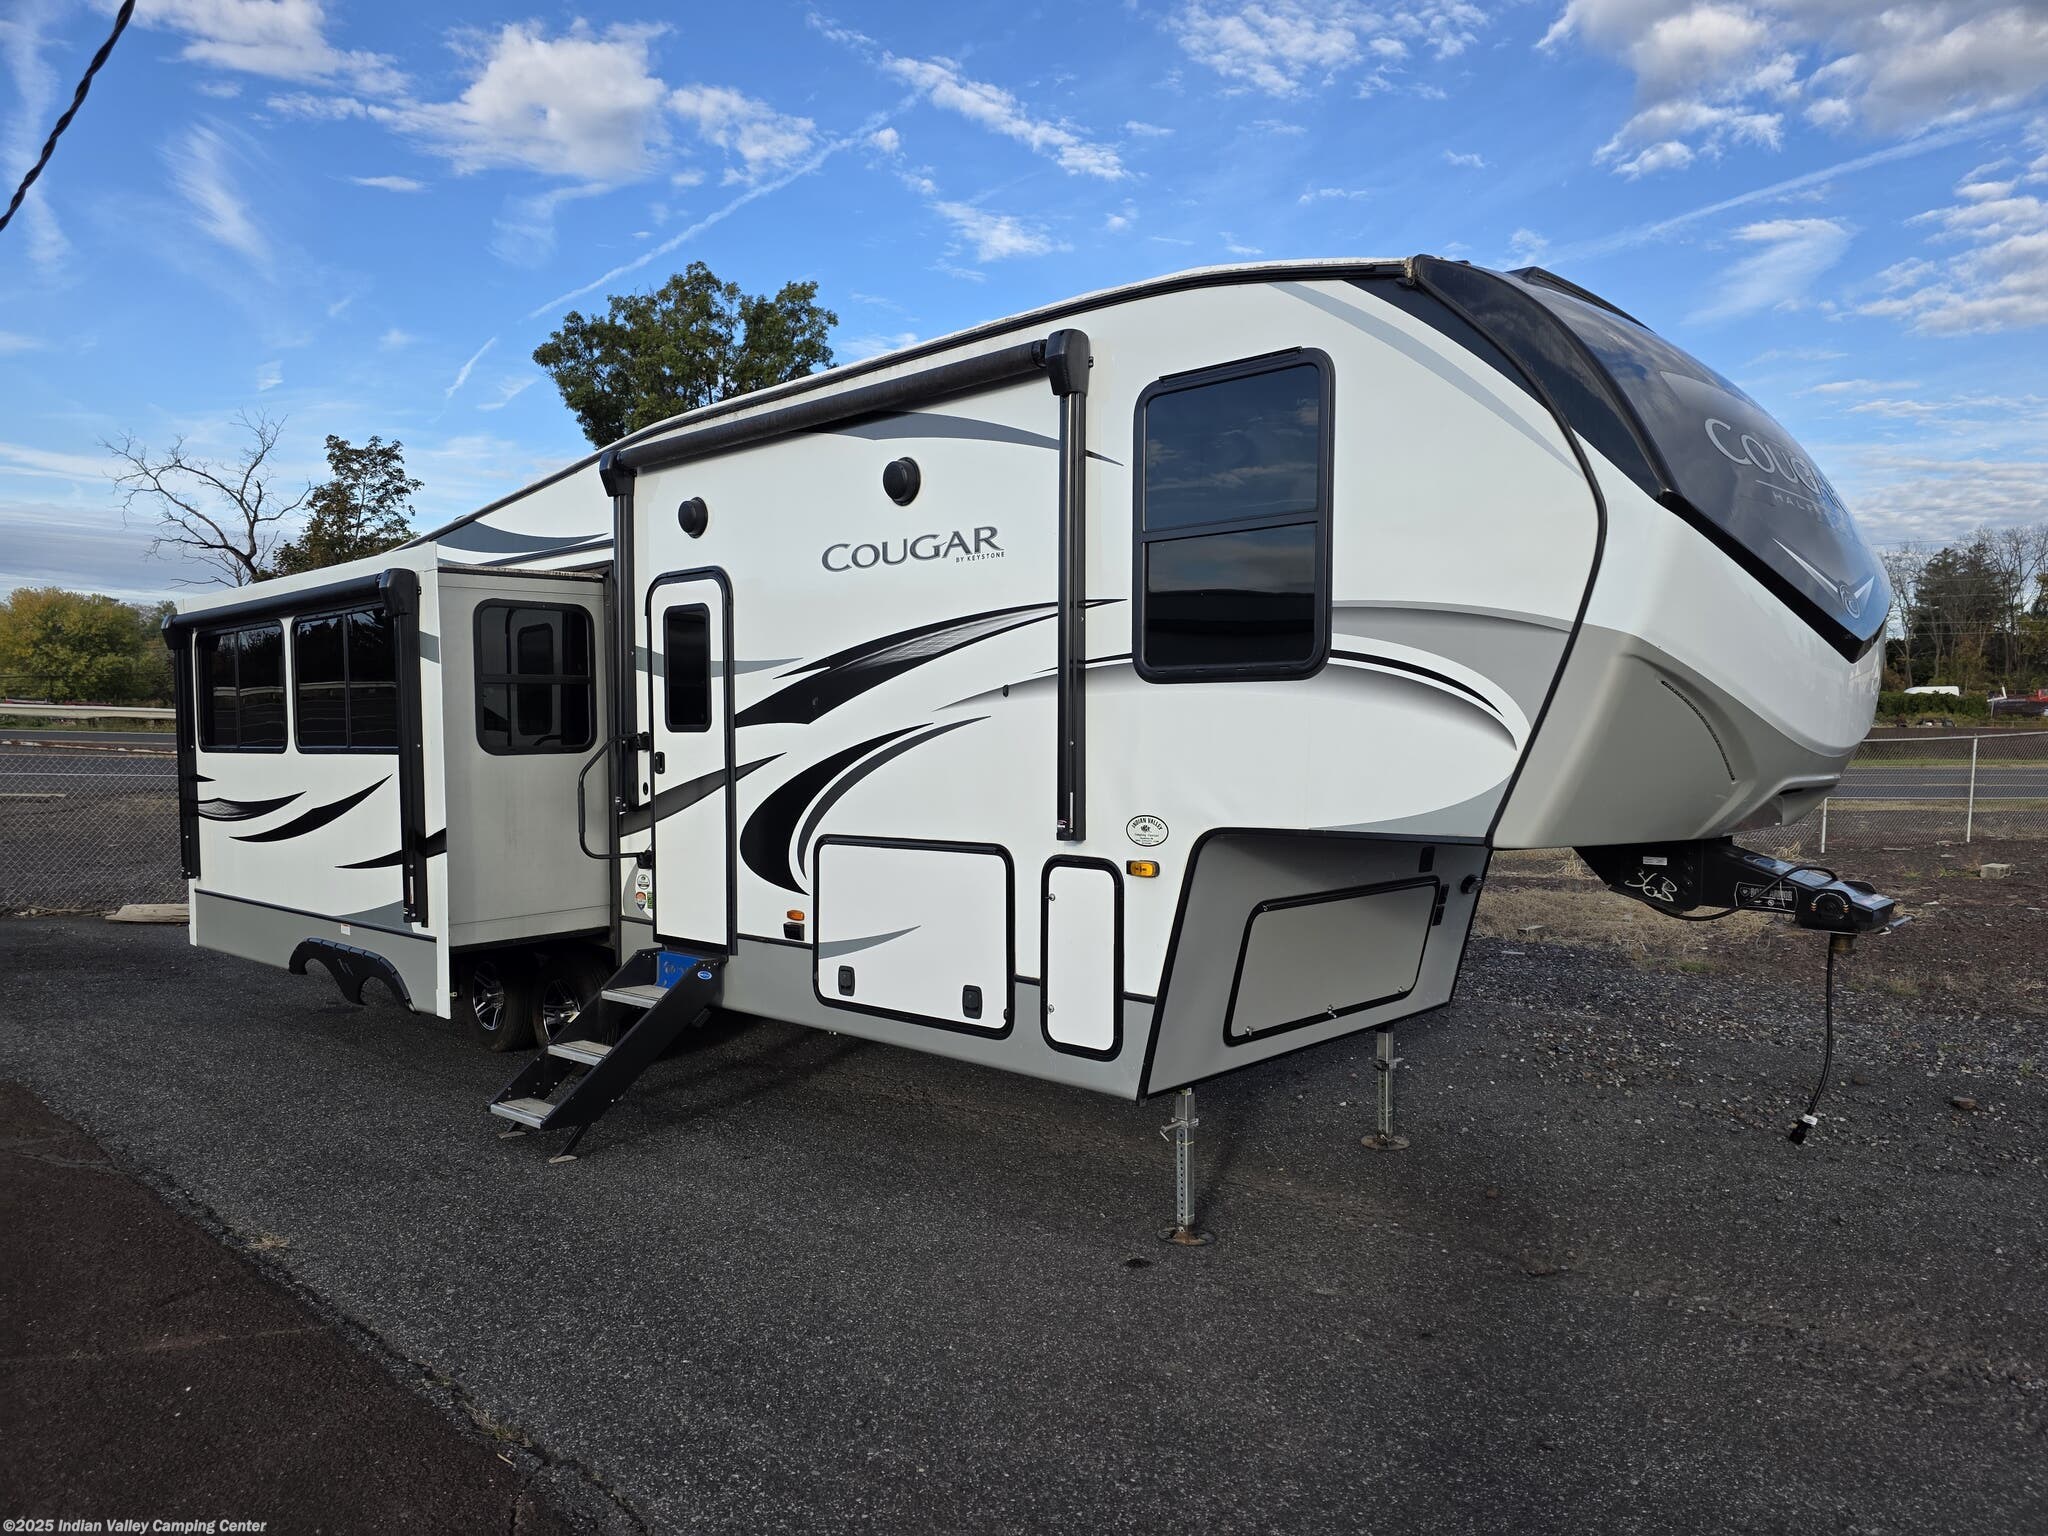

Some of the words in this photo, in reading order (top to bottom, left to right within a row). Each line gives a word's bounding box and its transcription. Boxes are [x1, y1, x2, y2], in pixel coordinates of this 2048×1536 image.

[821, 526, 1005, 573] COUGAR
[967, 551, 1005, 561] KEYSTONE
[1147, 818, 1163, 830] VALLEY
